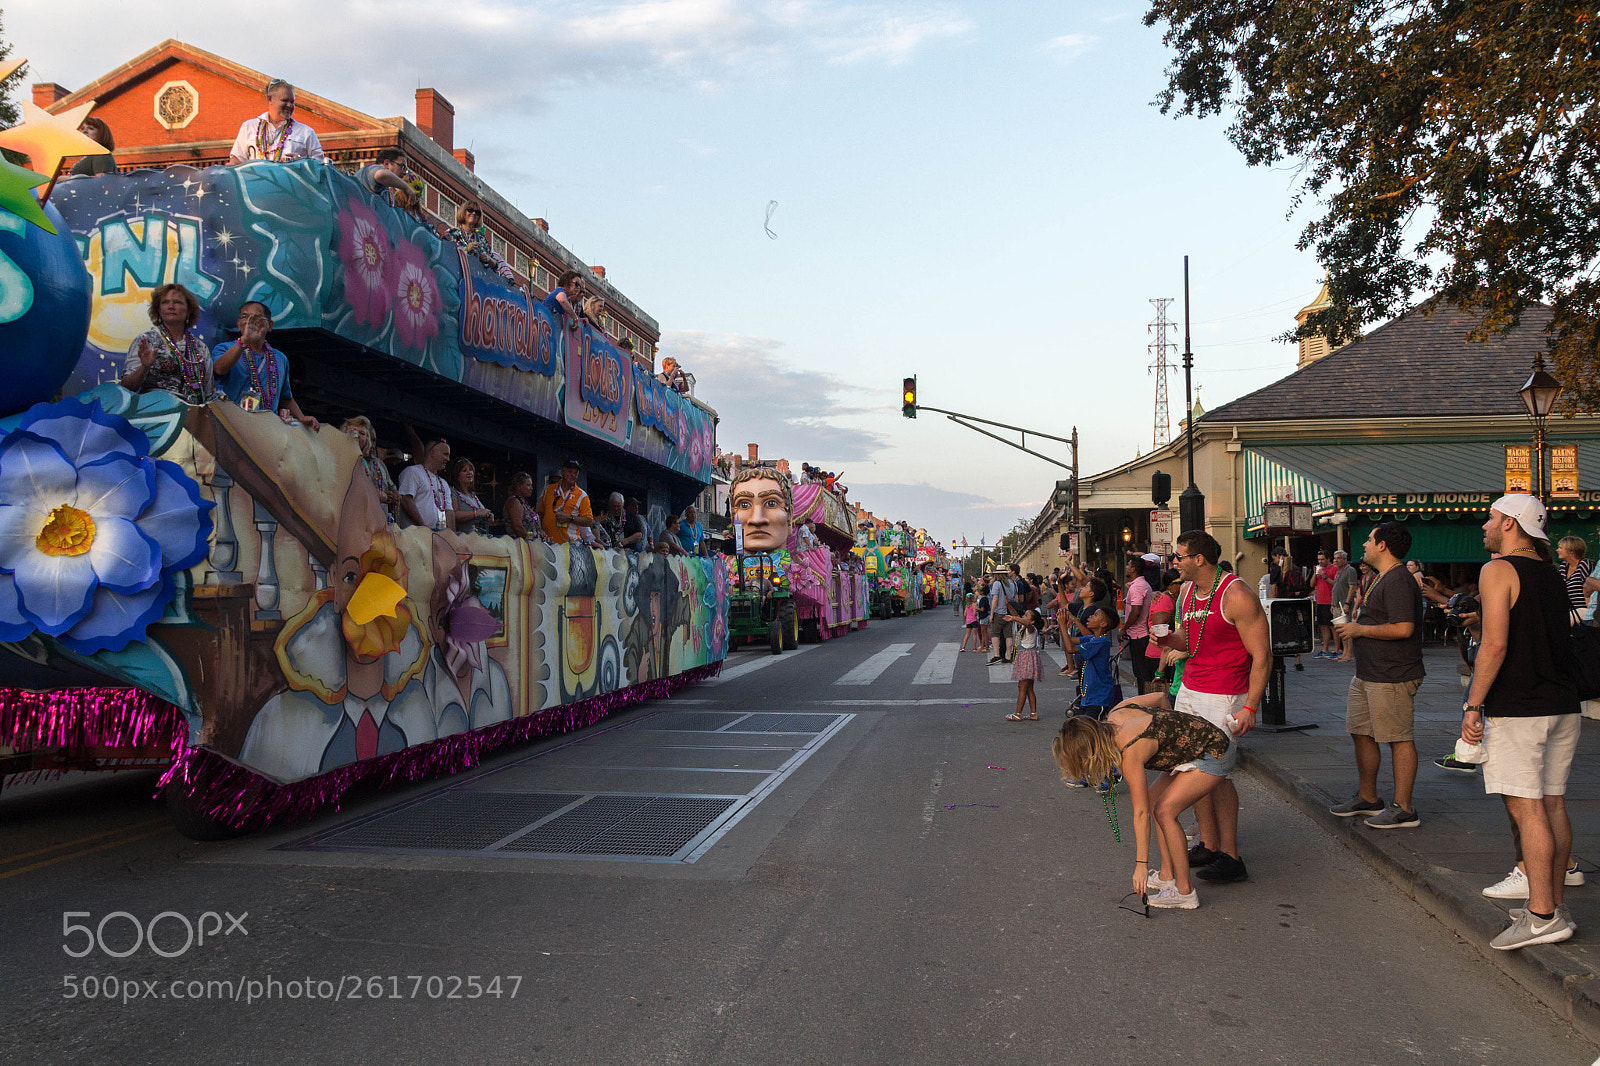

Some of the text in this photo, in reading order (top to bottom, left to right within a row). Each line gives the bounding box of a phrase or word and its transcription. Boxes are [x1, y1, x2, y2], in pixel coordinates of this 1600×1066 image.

[72, 211, 224, 307] NL
[458, 250, 552, 366] harrah's
[1507, 448, 1530, 457] MAKING
[1552, 448, 1576, 457] MAKING
[1507, 456, 1530, 464] HISTORY
[1552, 456, 1576, 464] HISTORY
[1357, 493, 1491, 505] CAFE DU MONDE
